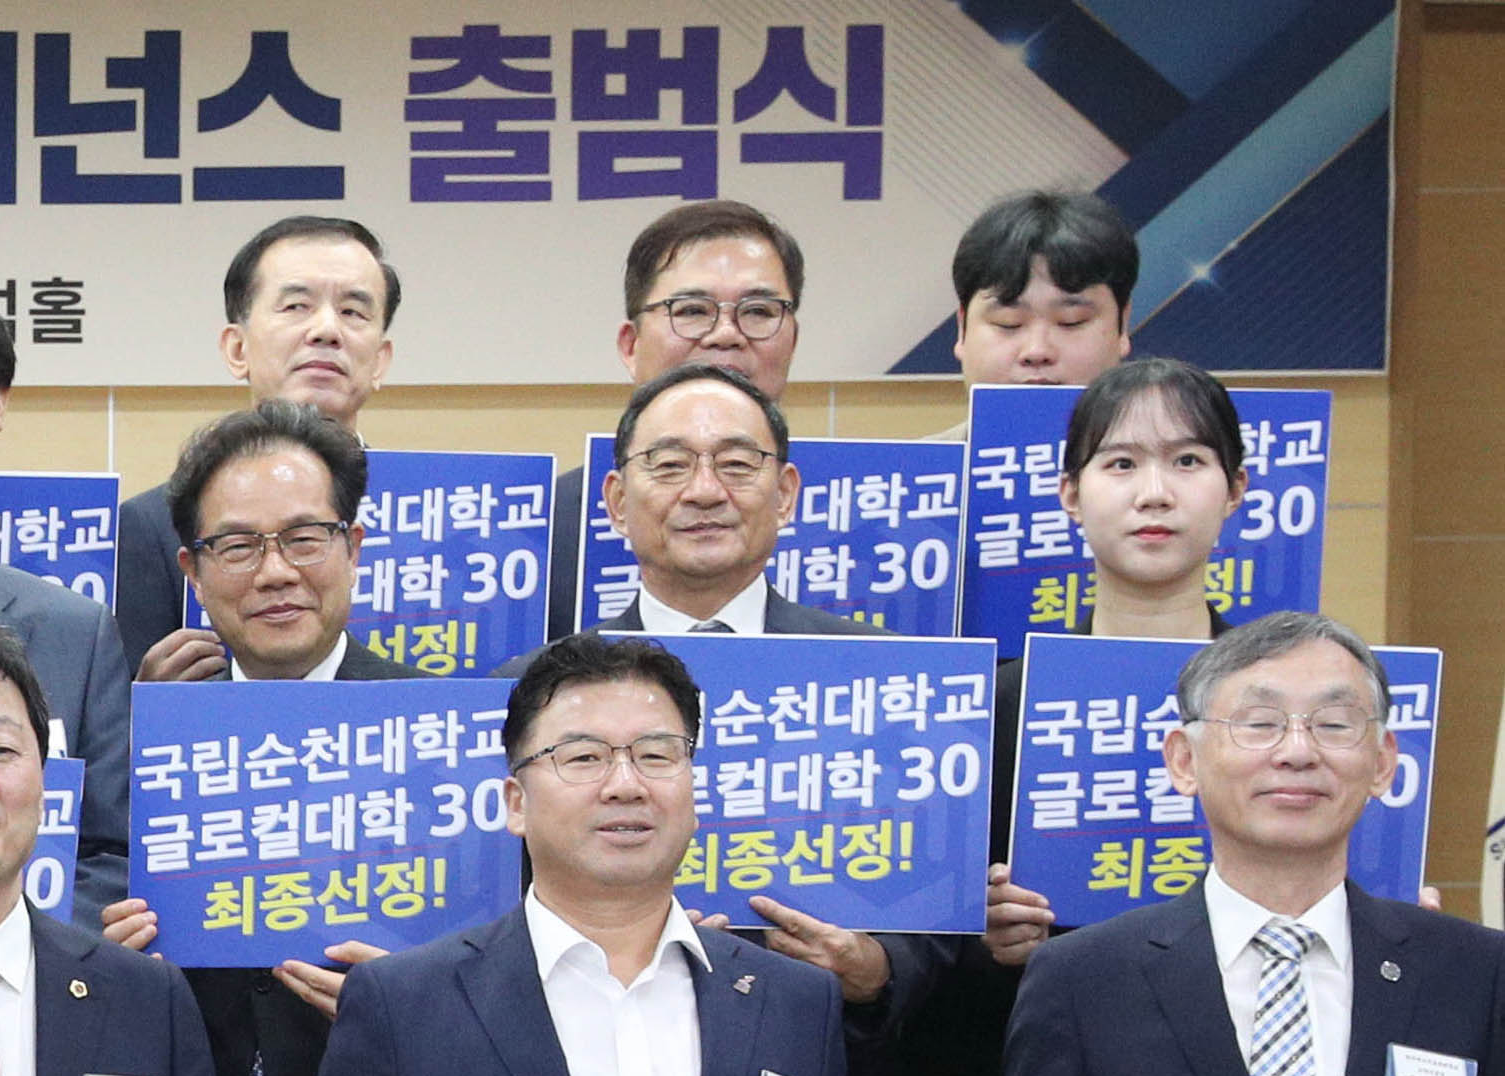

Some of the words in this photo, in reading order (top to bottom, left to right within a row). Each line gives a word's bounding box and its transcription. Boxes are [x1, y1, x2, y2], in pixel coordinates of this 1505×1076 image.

[403, 22, 883, 202] 출범식
[354, 482, 547, 548] 천대학교
[1240, 485, 1316, 541] 30
[462, 549, 539, 603] 30
[869, 538, 950, 594] 30
[368, 621, 478, 676] 선정!
[696, 673, 989, 749] 순천대학교
[135, 709, 509, 801] 국립순천대학교
[692, 749, 882, 818] 컬대학
[896, 742, 981, 801] 30
[1028, 765, 1196, 829] 글로컬
[1366, 752, 1419, 809] 0
[141, 786, 413, 874] 글로컬대학
[429, 777, 509, 839] 30
[673, 819, 913, 893] 최종선정!
[25, 857, 65, 911] 0
[202, 856, 447, 936] 최종선정!
